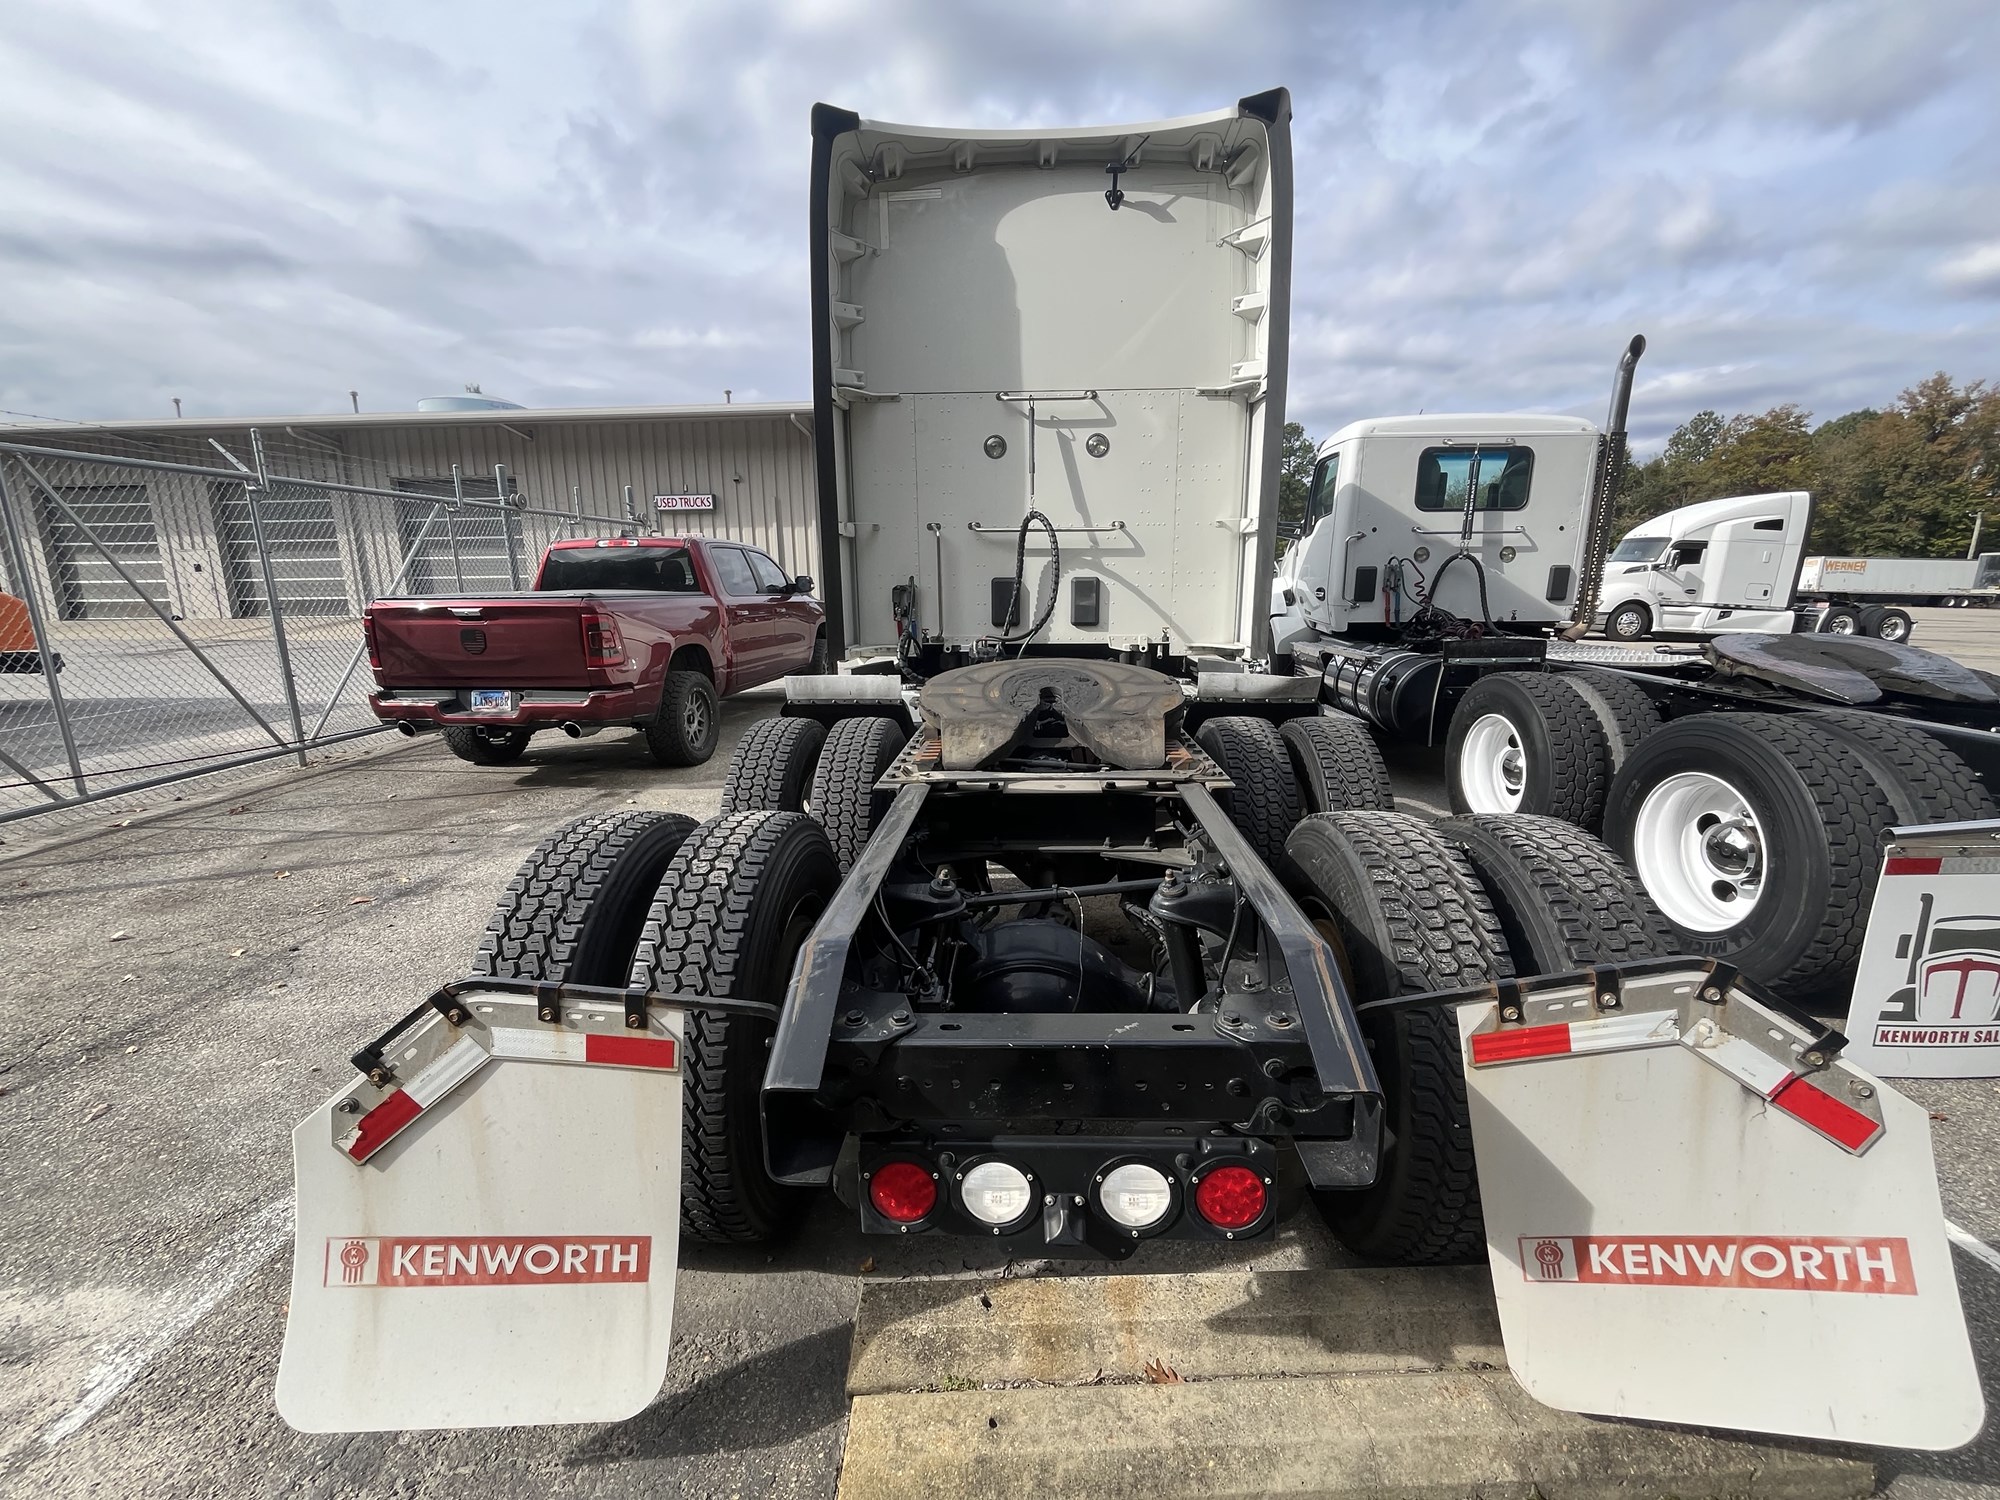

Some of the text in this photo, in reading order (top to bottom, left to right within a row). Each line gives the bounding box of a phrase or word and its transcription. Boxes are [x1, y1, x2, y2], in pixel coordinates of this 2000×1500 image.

[656, 497, 711, 508] USED TRUCKS
[1825, 560, 1867, 572] WERNER
[1880, 1030, 1970, 1043] KENWORTH
[392, 1243, 639, 1277] KENWORTH
[1588, 1243, 1898, 1283] KENWORTH
